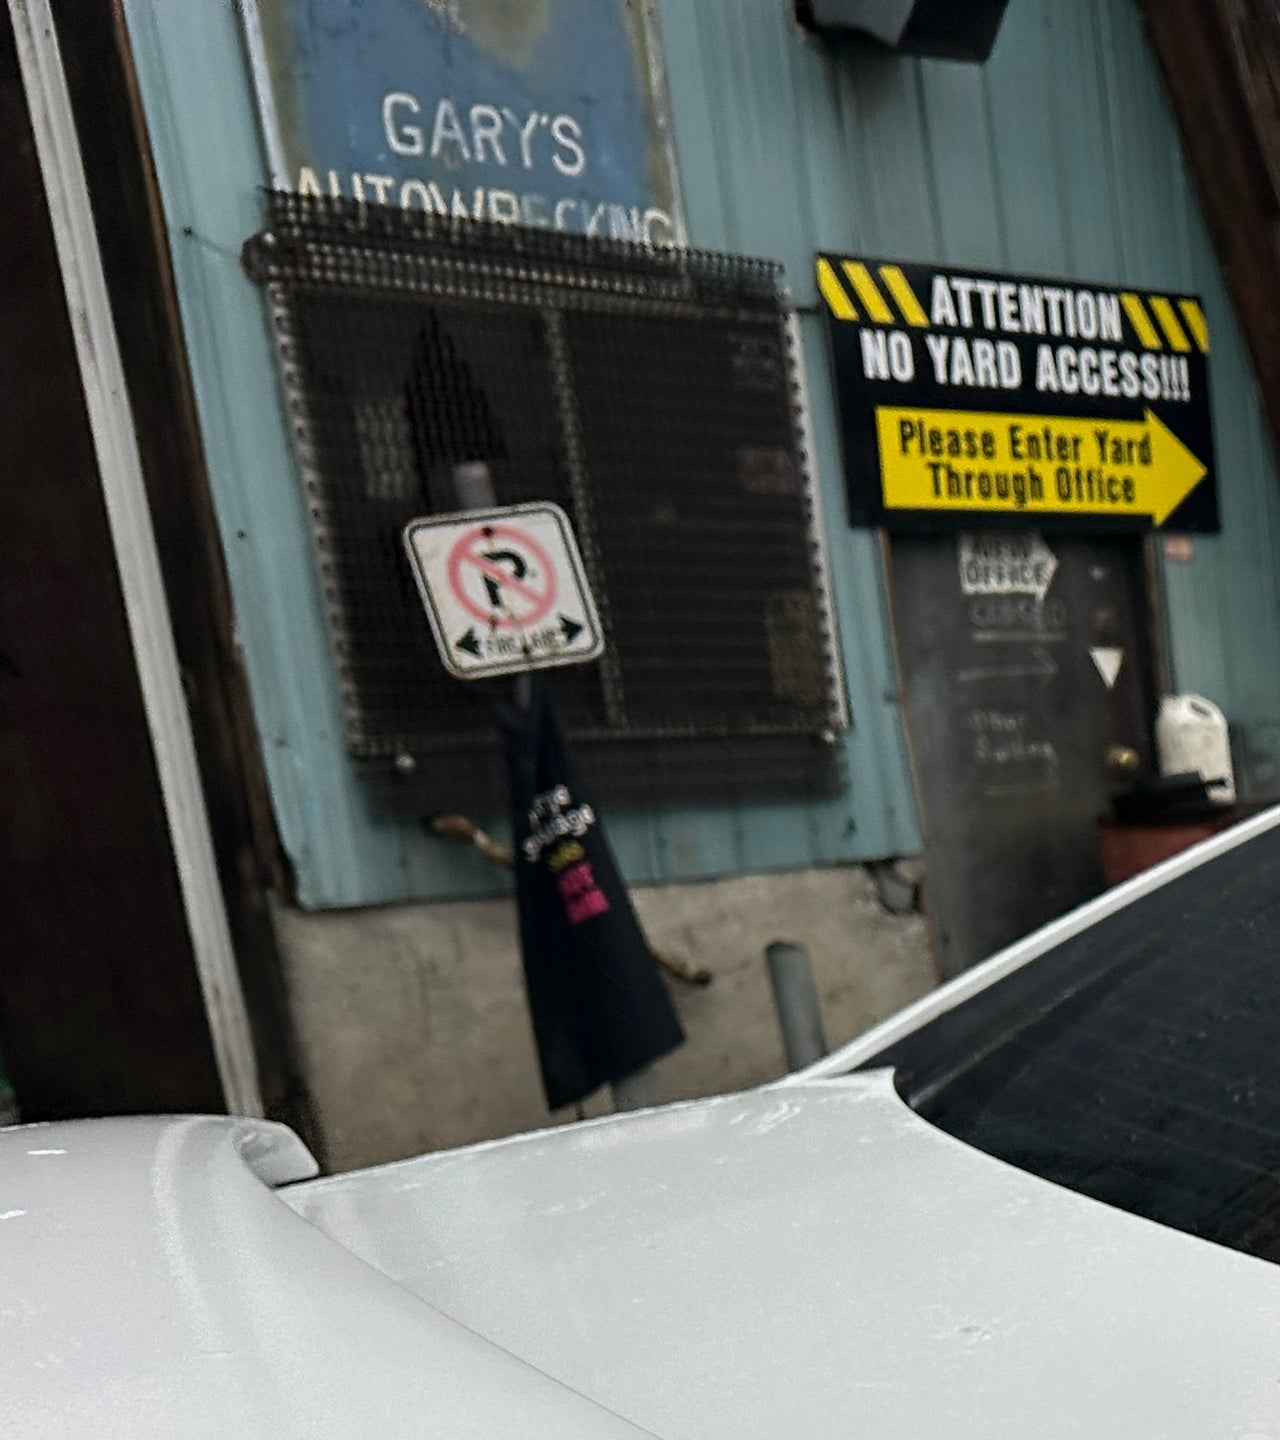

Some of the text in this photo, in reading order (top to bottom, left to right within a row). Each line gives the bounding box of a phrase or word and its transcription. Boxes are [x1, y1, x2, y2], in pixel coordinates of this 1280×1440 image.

[382, 92, 586, 177] GARY'S
[931, 273, 1124, 343] ATTENTION
[859, 327, 1191, 402] NO YARD ACCESS!!!
[899, 418, 1153, 468] Please Enter Yard
[926, 461, 1136, 507] Through Office
